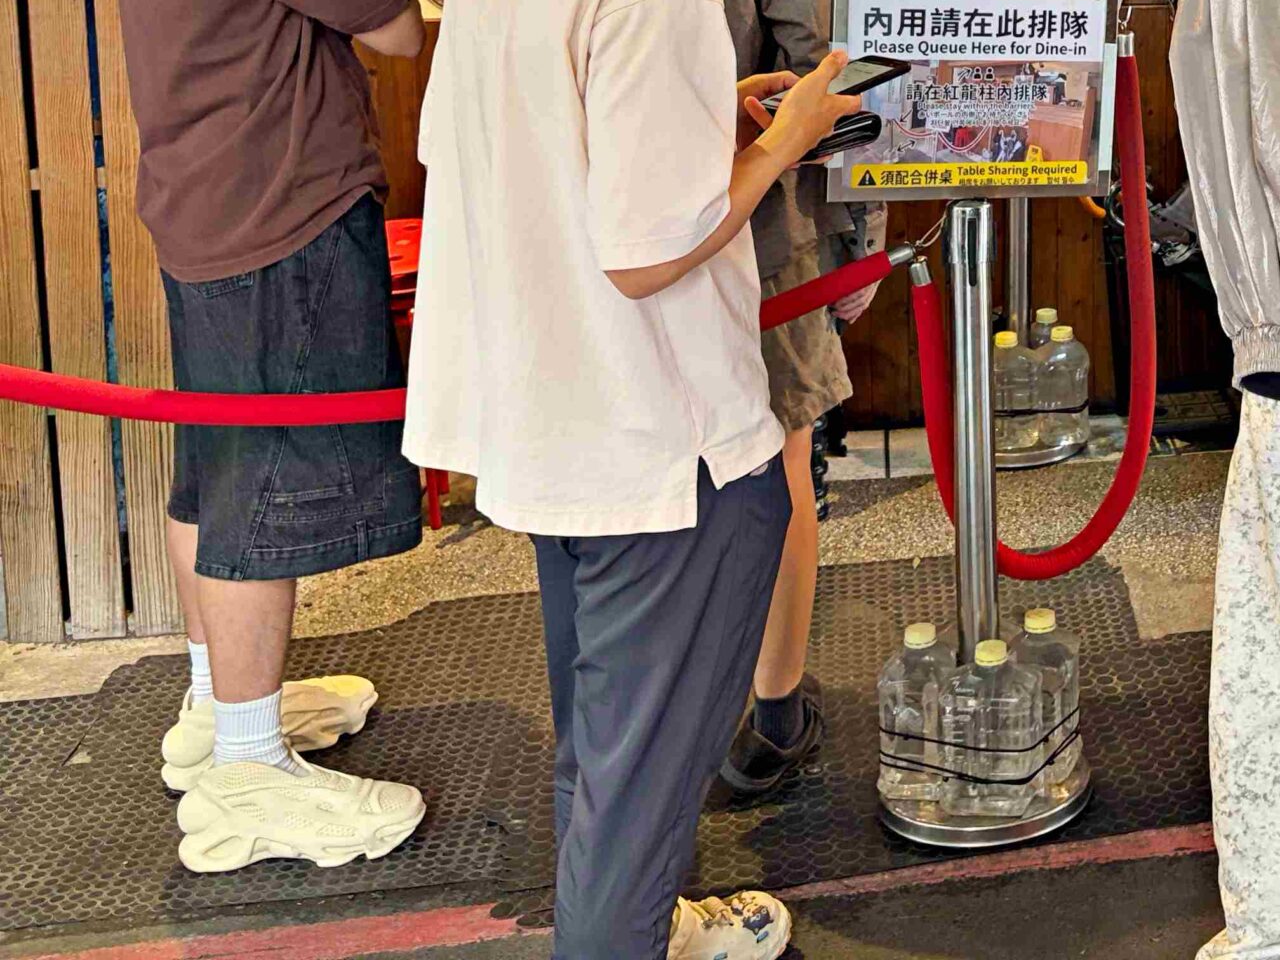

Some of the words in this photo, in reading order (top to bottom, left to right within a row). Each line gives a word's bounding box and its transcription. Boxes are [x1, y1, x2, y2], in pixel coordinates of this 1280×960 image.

[863, 6, 1089, 39] 內用請在此排隊
[863, 40, 914, 54] Please
[918, 40, 967, 56] Queue
[972, 41, 1006, 55] Here
[1010, 41, 1031, 55] for
[1035, 41, 1087, 56] Dine-in
[906, 83, 1048, 102] 請在紅龍柱內排隊
[880, 169, 953, 186] 須配合併桌
[957, 166, 985, 177] Table
[988, 165, 1029, 178] Sharing
[1031, 164, 1077, 177] Required
